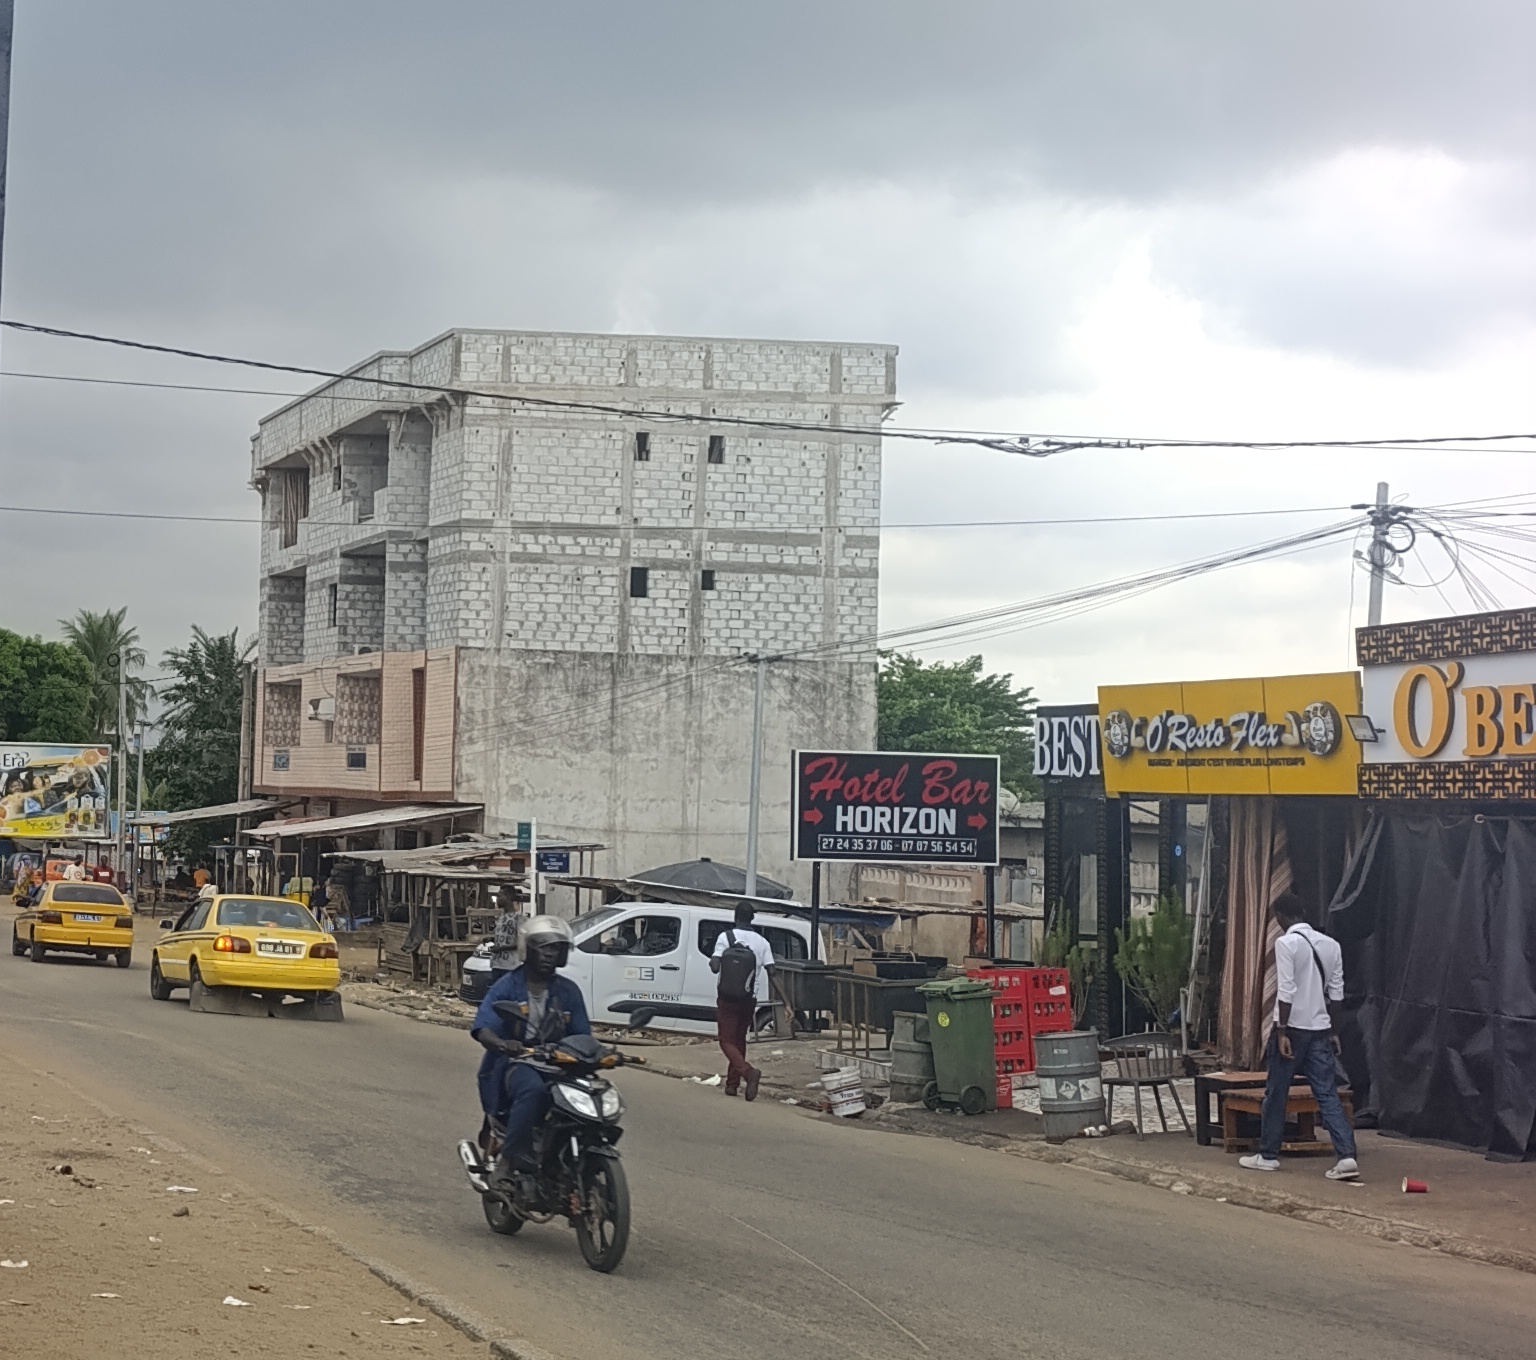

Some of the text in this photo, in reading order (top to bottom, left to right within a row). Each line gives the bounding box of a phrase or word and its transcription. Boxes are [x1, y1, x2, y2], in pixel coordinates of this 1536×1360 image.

[1032, 714, 1102, 778] BEST
[1146, 710, 1280, 753] O'Resto Flex
[3, 753, 25, 767] Era
[804, 756, 992, 806] Hotel Bar
[835, 804, 957, 836] HORIZON
